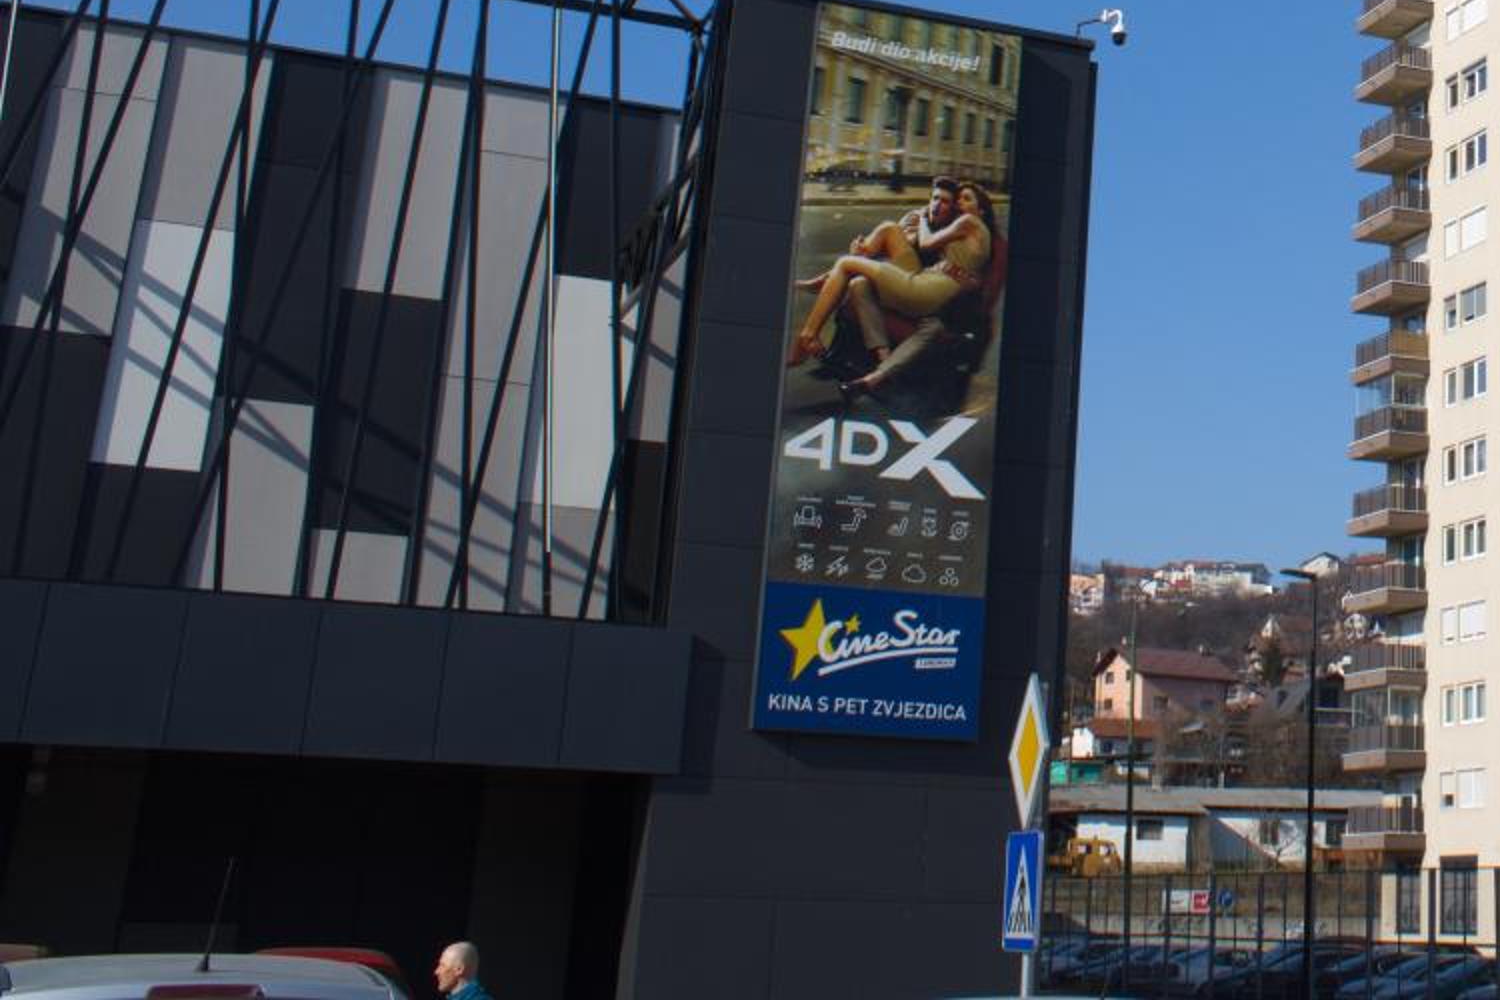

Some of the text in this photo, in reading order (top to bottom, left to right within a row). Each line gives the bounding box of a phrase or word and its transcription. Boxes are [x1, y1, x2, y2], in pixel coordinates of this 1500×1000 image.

[831, 31, 982, 72] Budi dio akcije!
[783, 416, 987, 500] 4DX
[817, 609, 961, 664] CineStar
[767, 693, 967, 721] KINA S PET ZVJEZDICA
